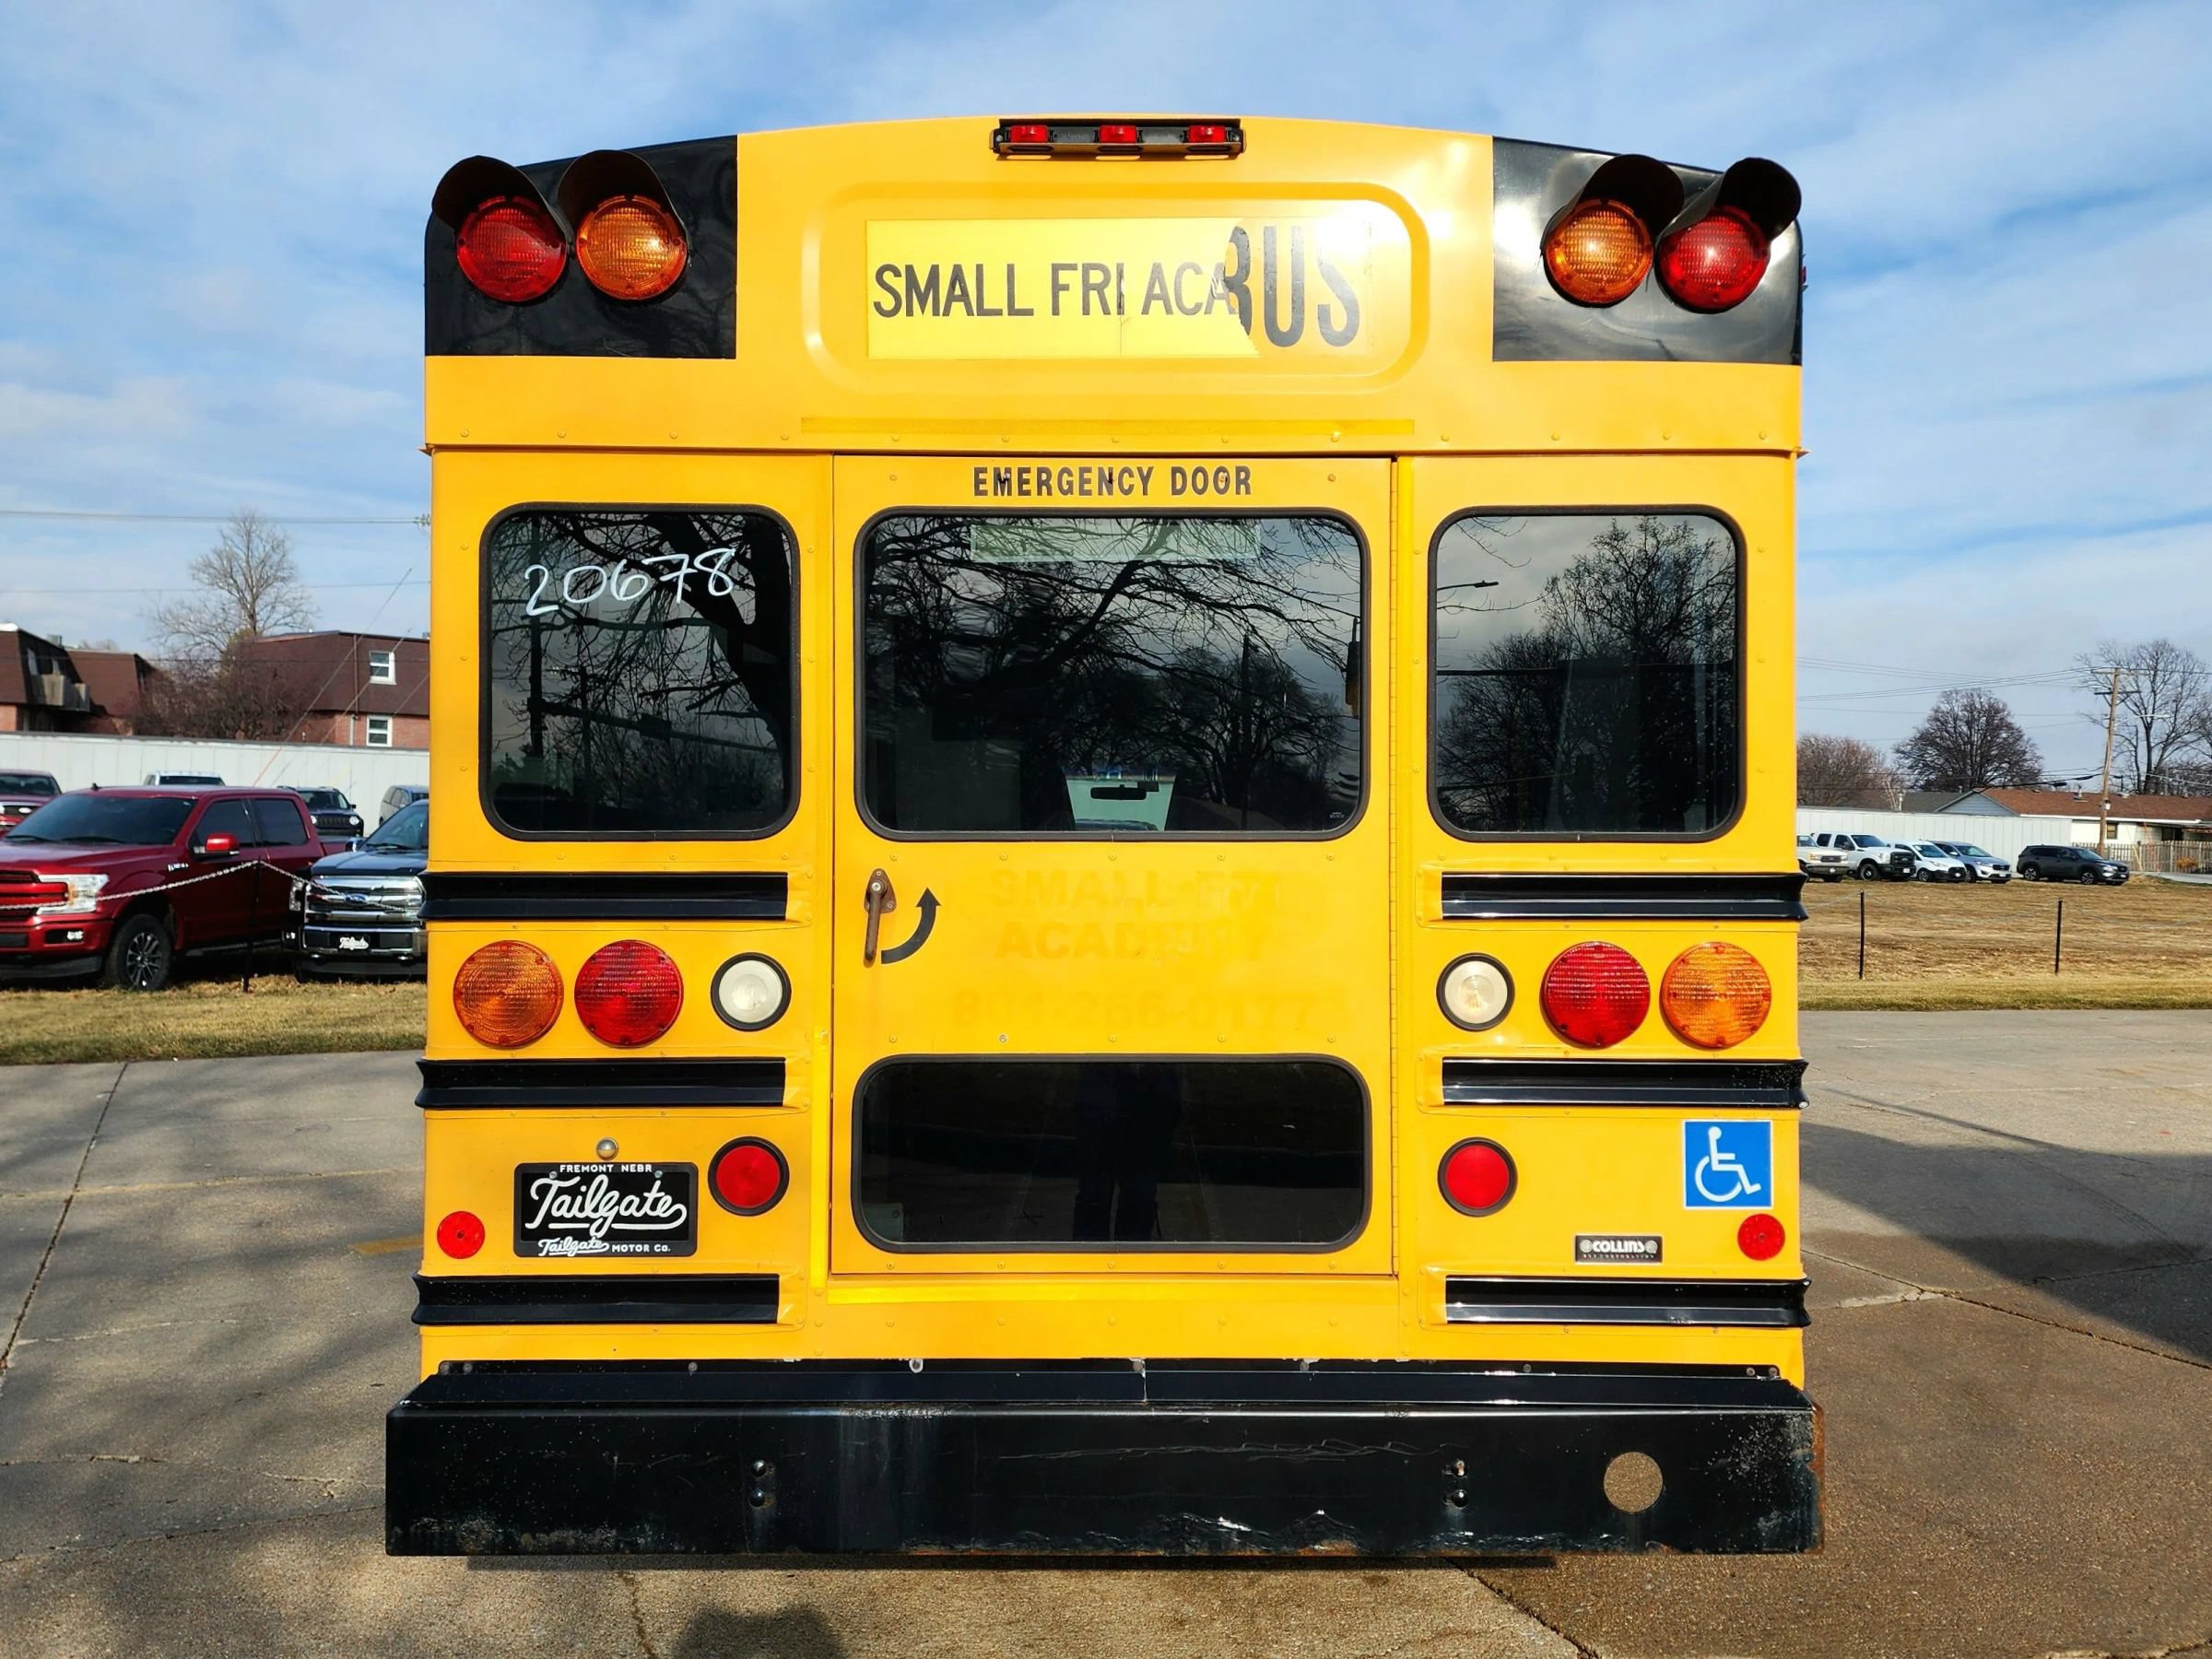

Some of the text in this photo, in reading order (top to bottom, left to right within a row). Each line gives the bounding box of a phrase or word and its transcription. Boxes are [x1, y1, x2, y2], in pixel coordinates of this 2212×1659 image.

[873, 263, 1034, 317] SMALL
[973, 465, 1252, 497] EMERGENCY DOOR
[524, 547, 736, 616] 20678
[559, 1164, 653, 1173] FREMONT NEBR
[524, 1174, 688, 1239] Tailgate
[538, 1236, 609, 1257] Tailgate
[612, 1244, 649, 1253] MOTOR
